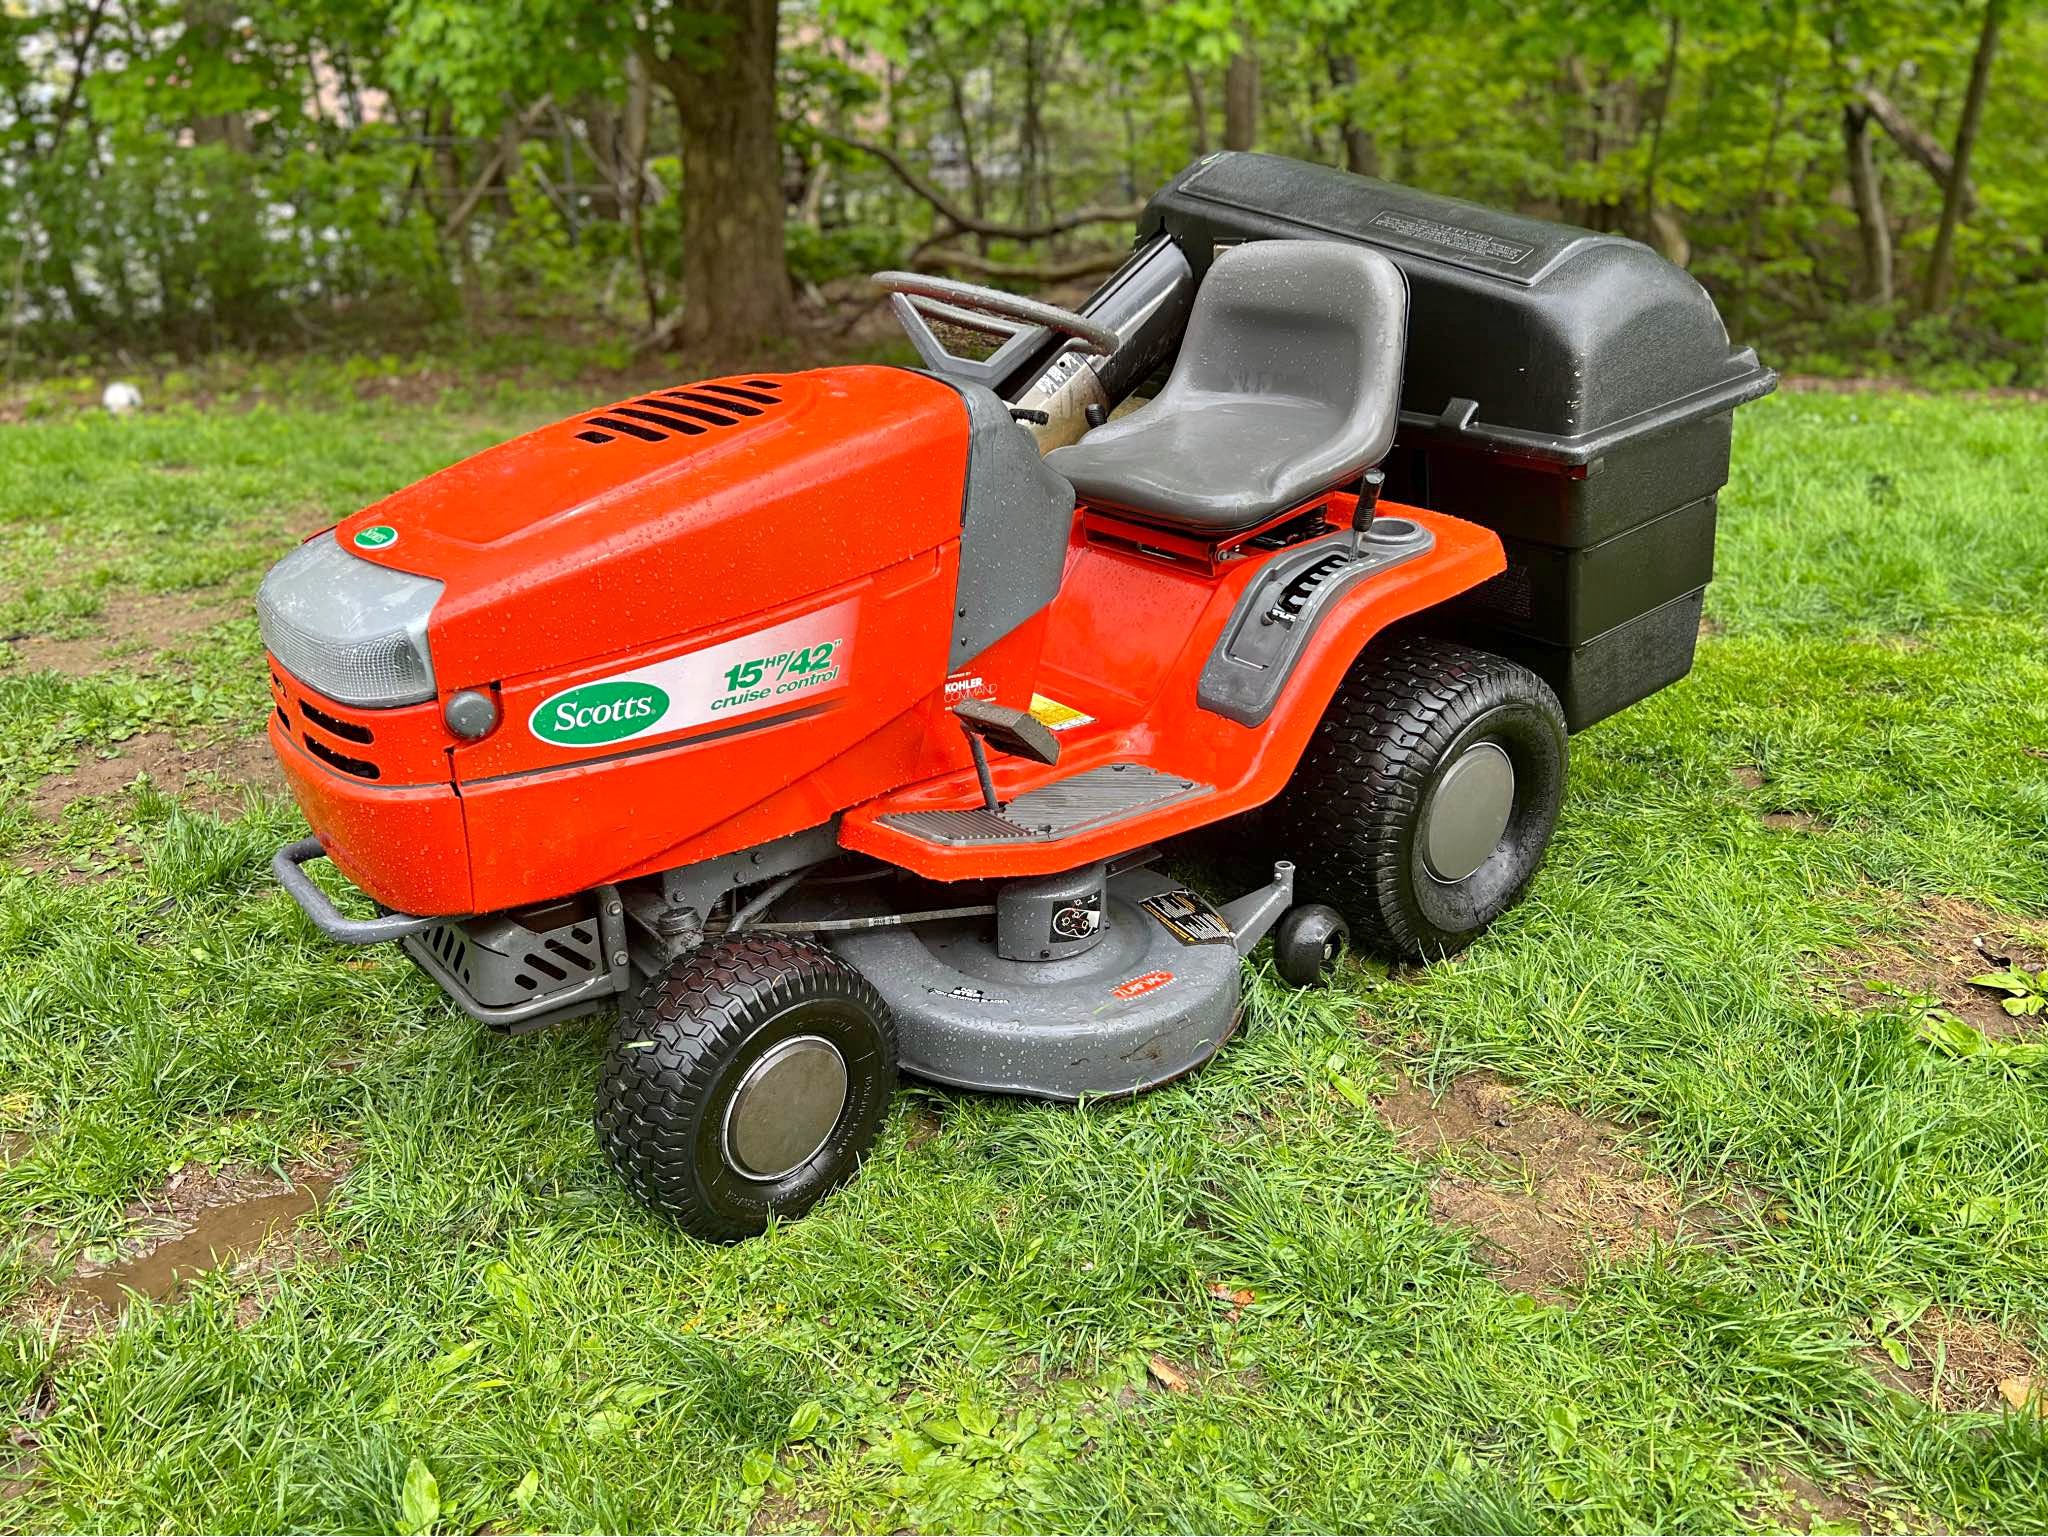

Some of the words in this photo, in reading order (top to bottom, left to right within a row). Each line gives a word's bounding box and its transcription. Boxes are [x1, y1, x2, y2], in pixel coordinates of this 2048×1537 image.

[710, 687, 771, 711] cruise
[775, 666, 839, 695] control
[943, 683, 998, 703] COMMAND
[944, 677, 983, 694] KOHLER
[553, 696, 653, 731] Scotts
